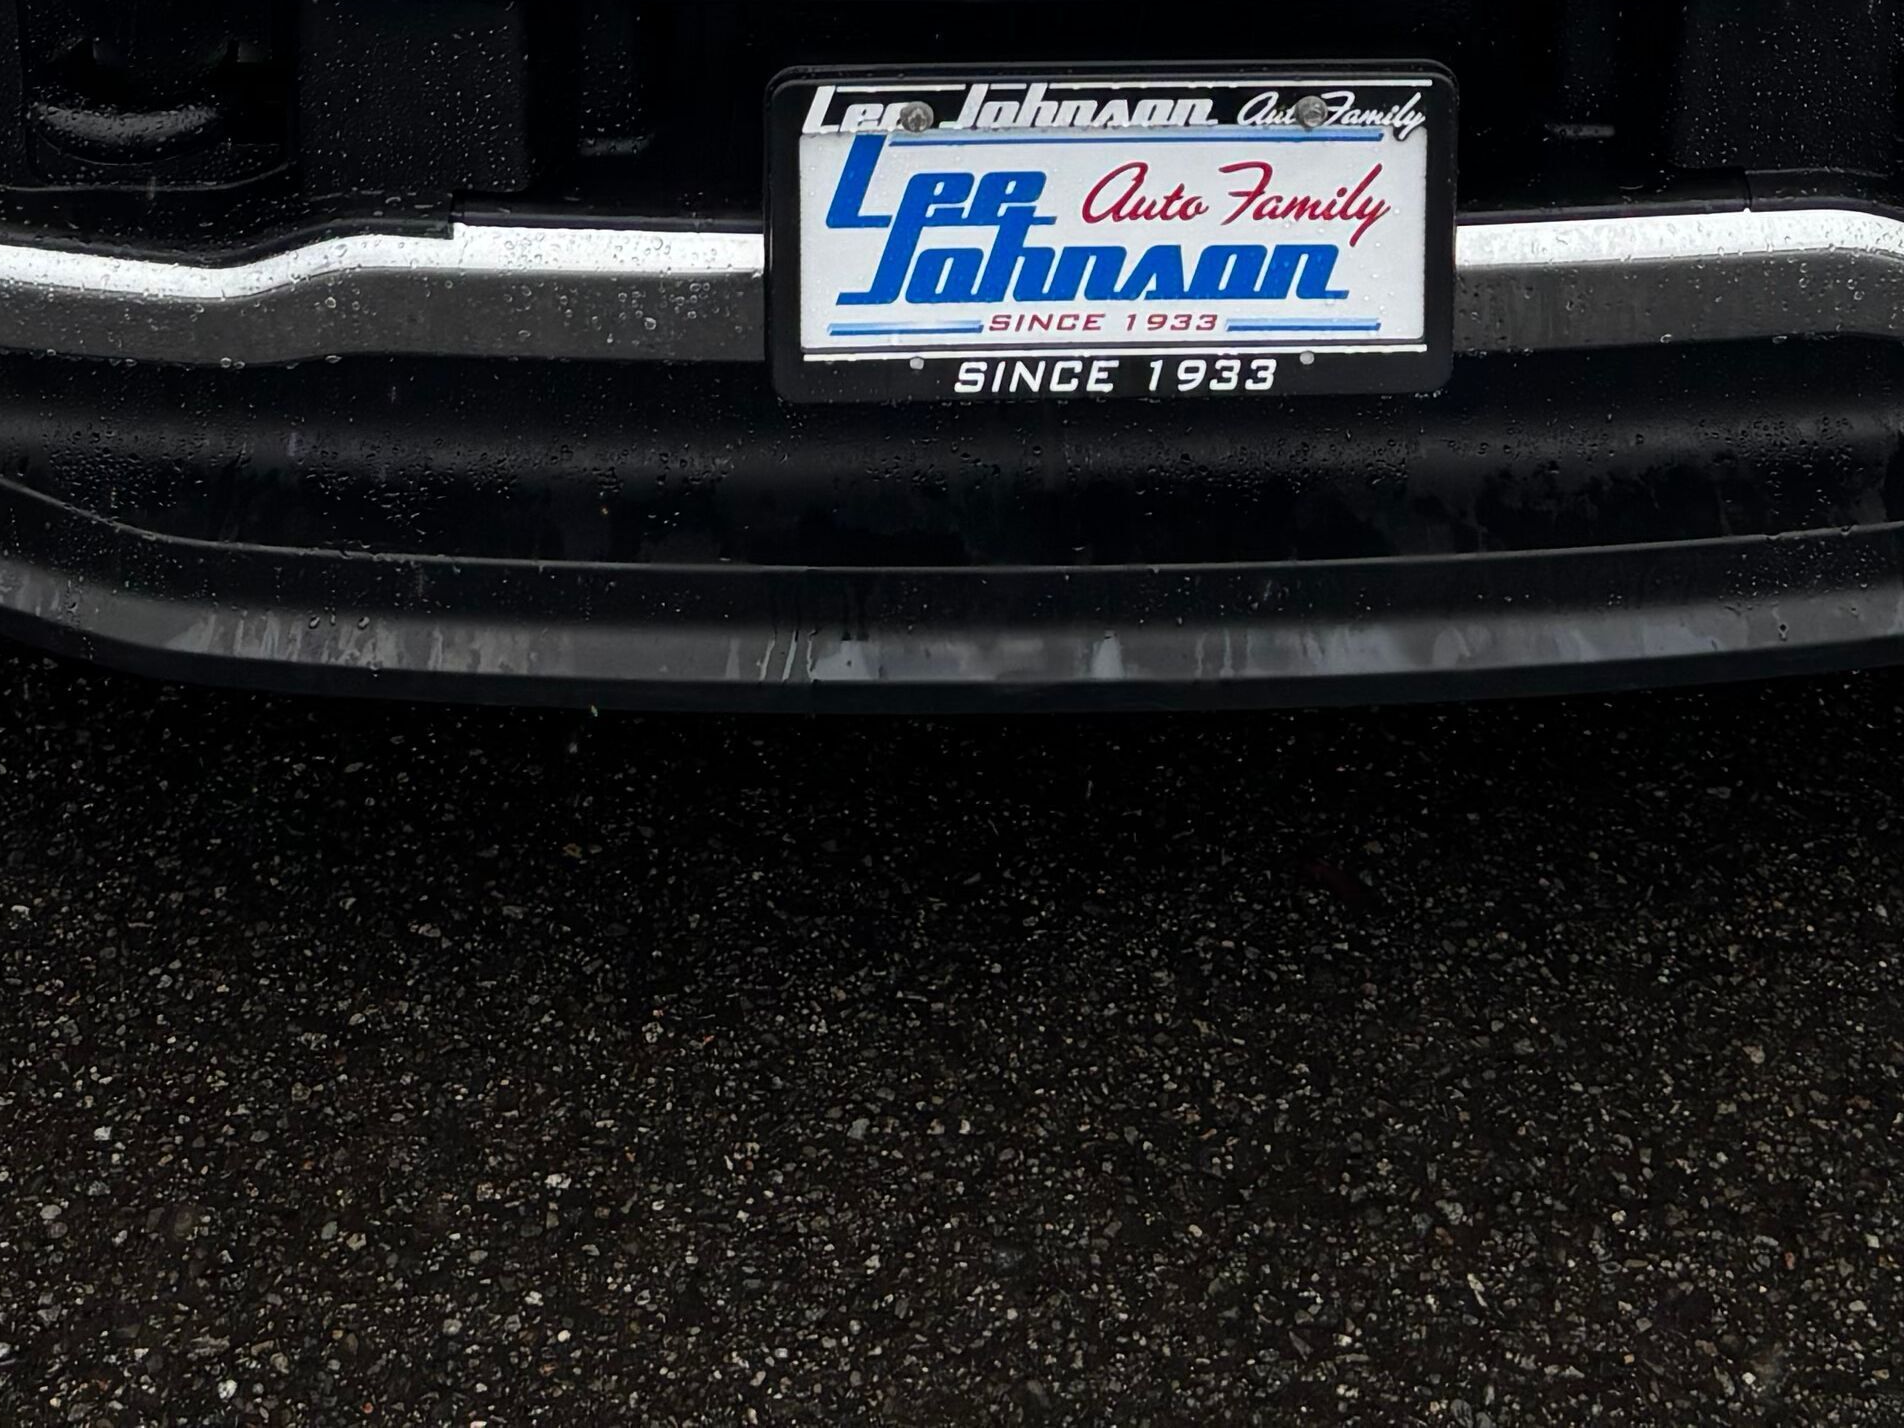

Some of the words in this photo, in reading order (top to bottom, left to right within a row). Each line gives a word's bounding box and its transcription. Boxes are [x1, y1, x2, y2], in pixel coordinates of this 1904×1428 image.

[939, 82, 1219, 130] Johnson
[1322, 90, 1427, 140] Family
[825, 134, 1057, 230] Lee
[1082, 162, 1210, 224] Auto
[1217, 161, 1393, 248] Family
[836, 206, 1350, 306] Johnson
[988, 313, 1108, 333] SINCE
[1126, 312, 1219, 332] 1933
[953, 359, 1120, 394] SINCE
[1147, 357, 1278, 392] 1933
